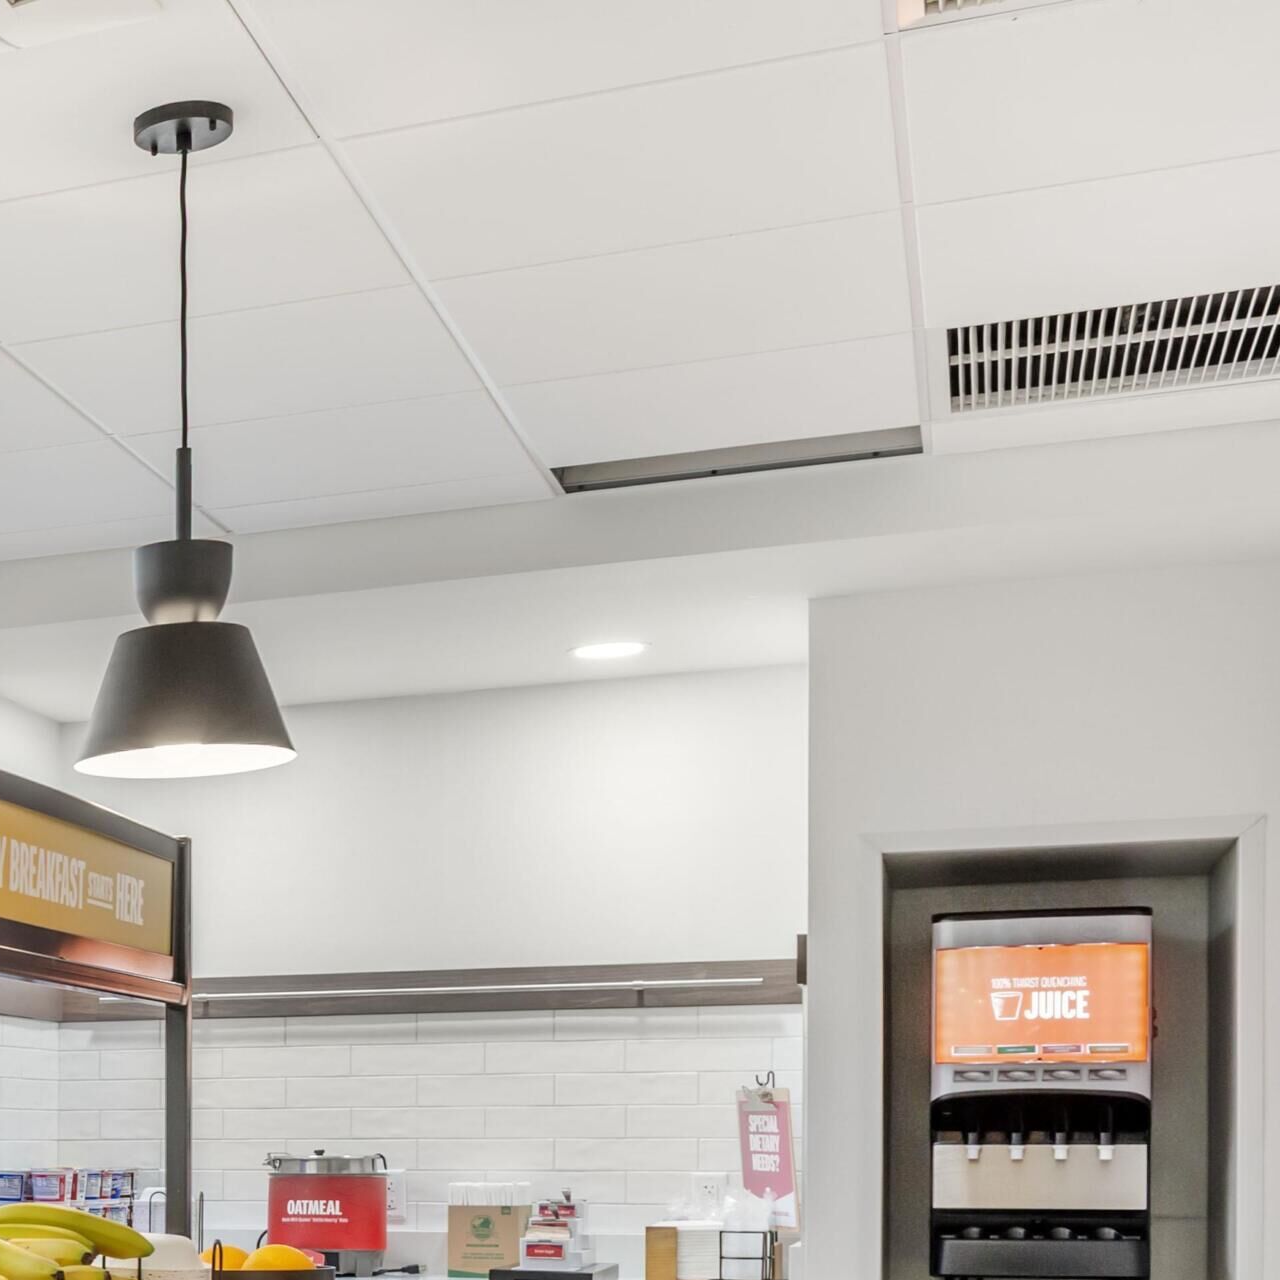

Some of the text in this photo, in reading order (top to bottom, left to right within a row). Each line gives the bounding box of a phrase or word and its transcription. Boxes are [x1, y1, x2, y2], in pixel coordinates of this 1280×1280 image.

[9, 839, 86, 910] BREAKFAST
[116, 872, 145, 926] HERE
[1023, 990, 1090, 1020] JUICE
[286, 1199, 343, 1216] OATMEAL
